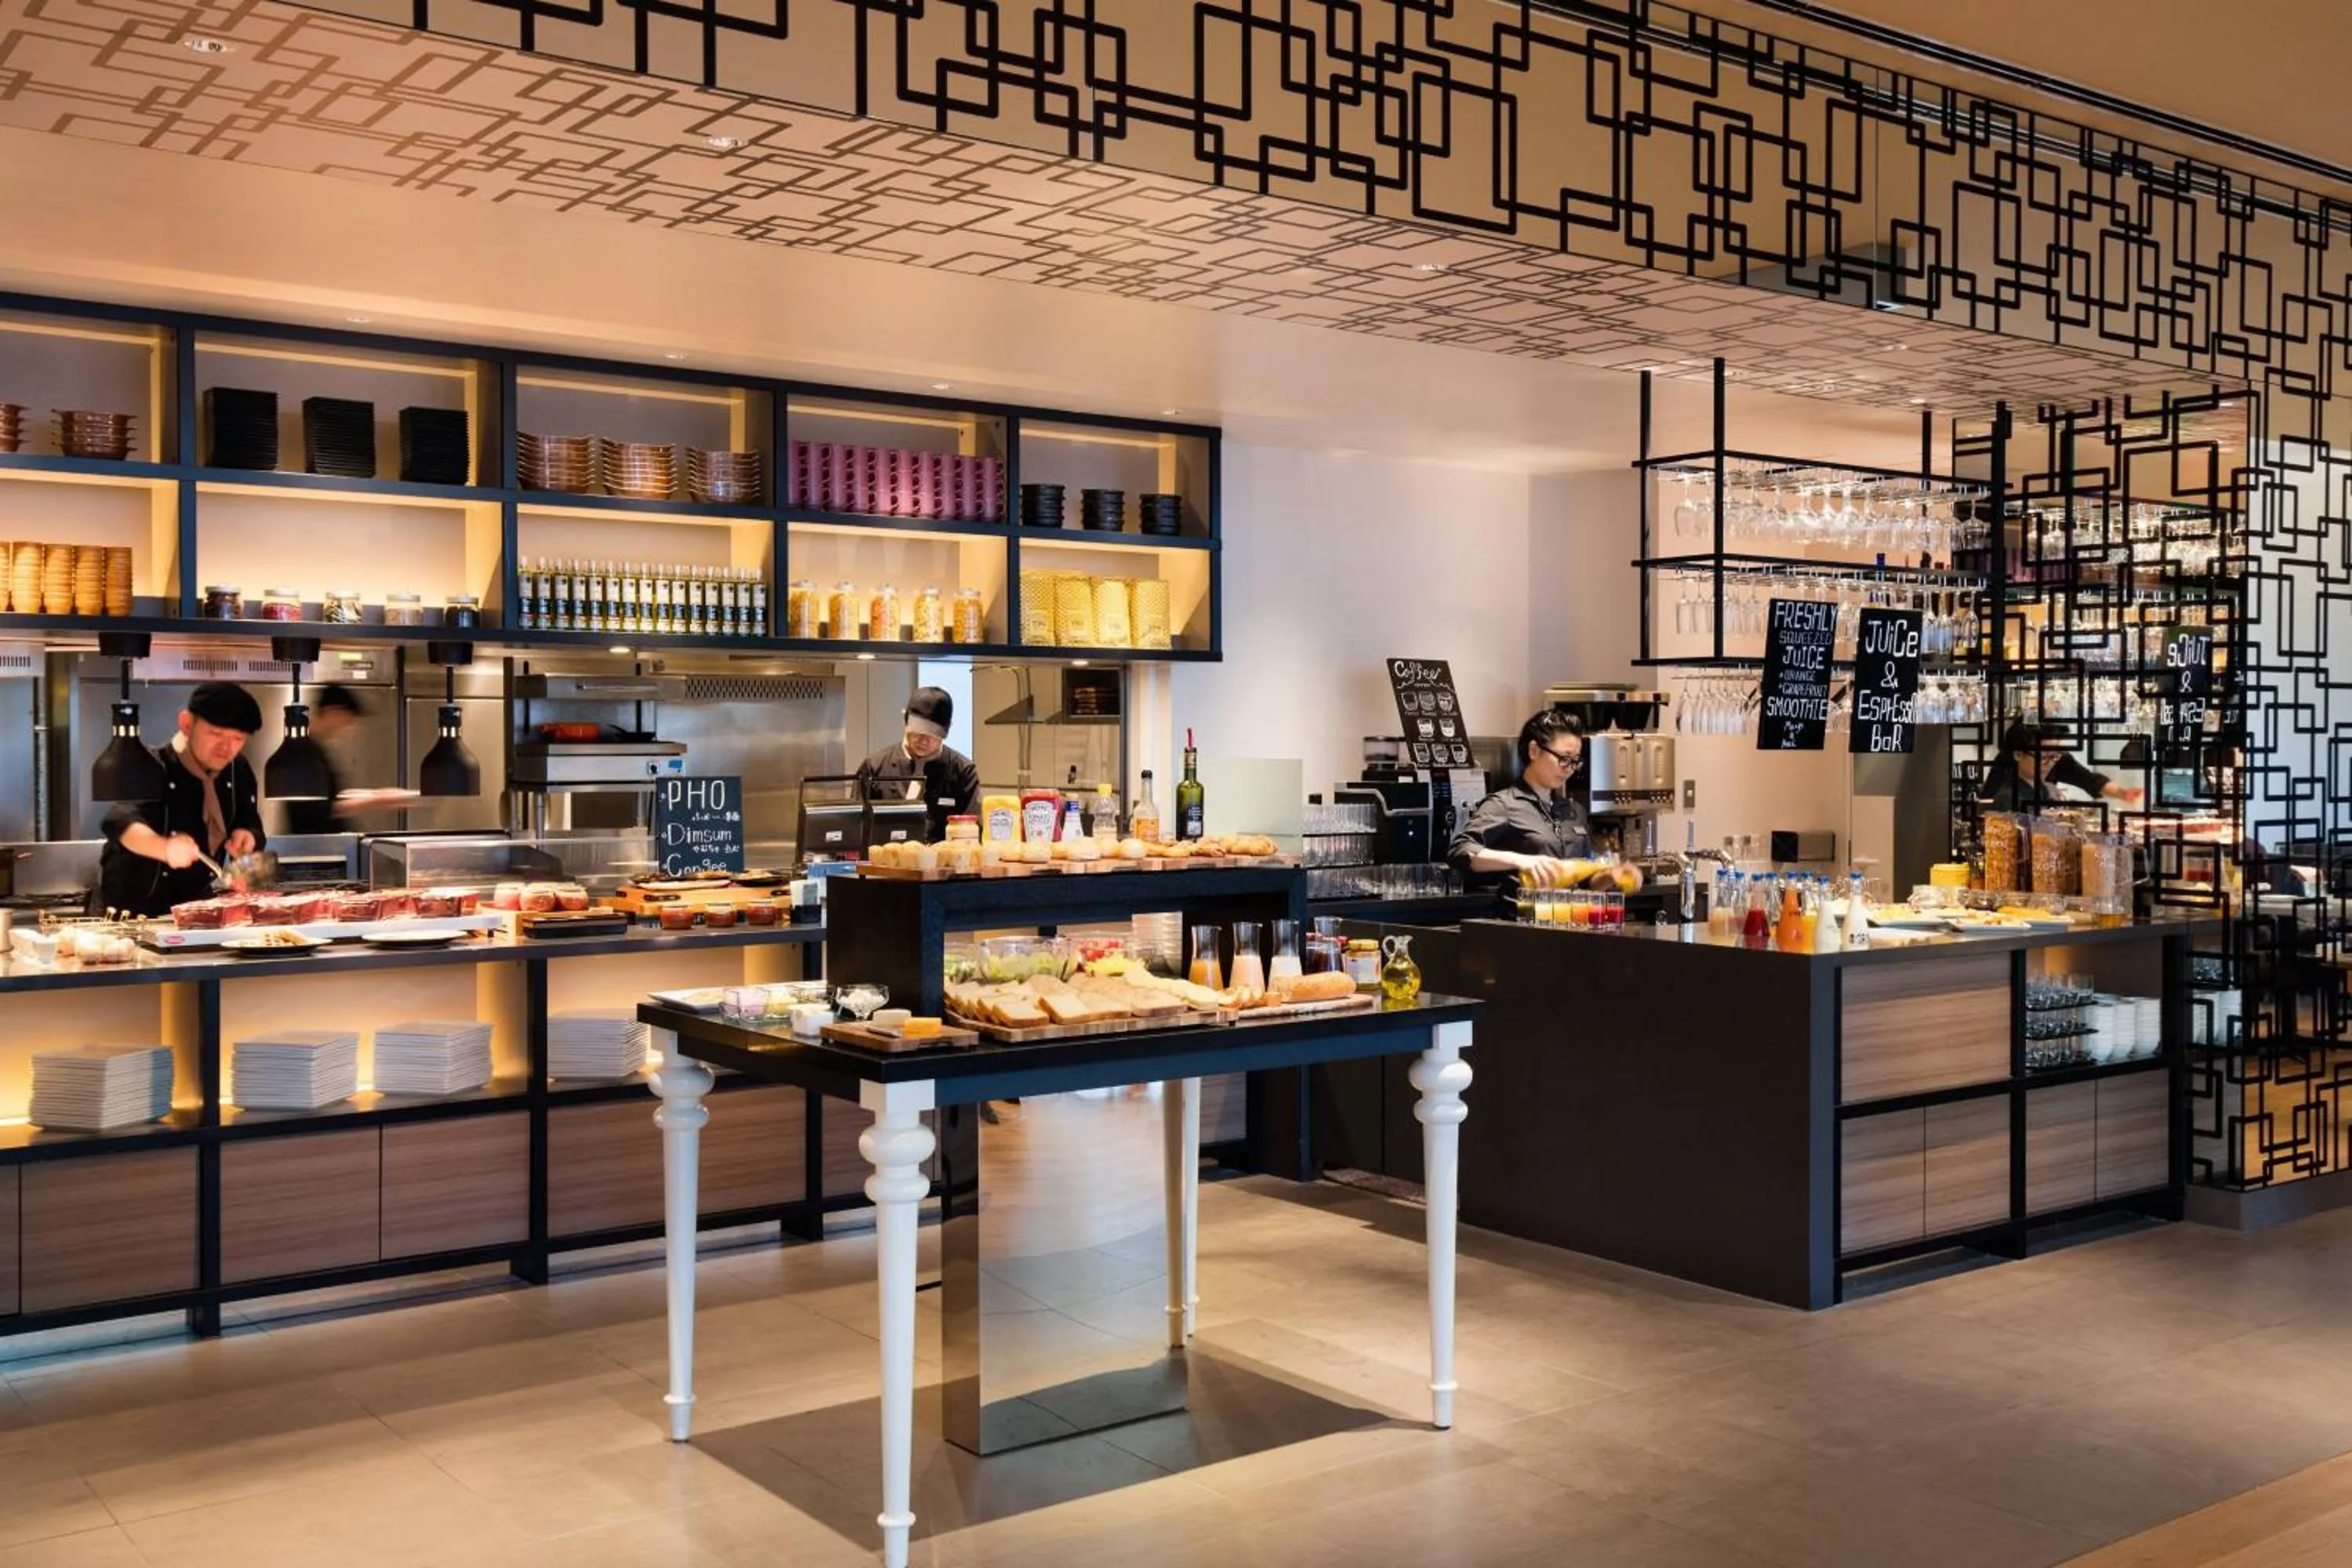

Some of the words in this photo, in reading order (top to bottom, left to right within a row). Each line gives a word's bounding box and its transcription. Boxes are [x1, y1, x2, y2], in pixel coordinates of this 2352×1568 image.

[1774, 601, 1836, 631] FRESHLY
[1779, 630, 1832, 645] SQUEEZED
[1782, 645, 1825, 670] JUICE
[1880, 661, 1899, 688] &
[1766, 695, 1828, 720] SMOOTHIE
[667, 780, 725, 811] PHO
[667, 822, 732, 846] Dimsum
